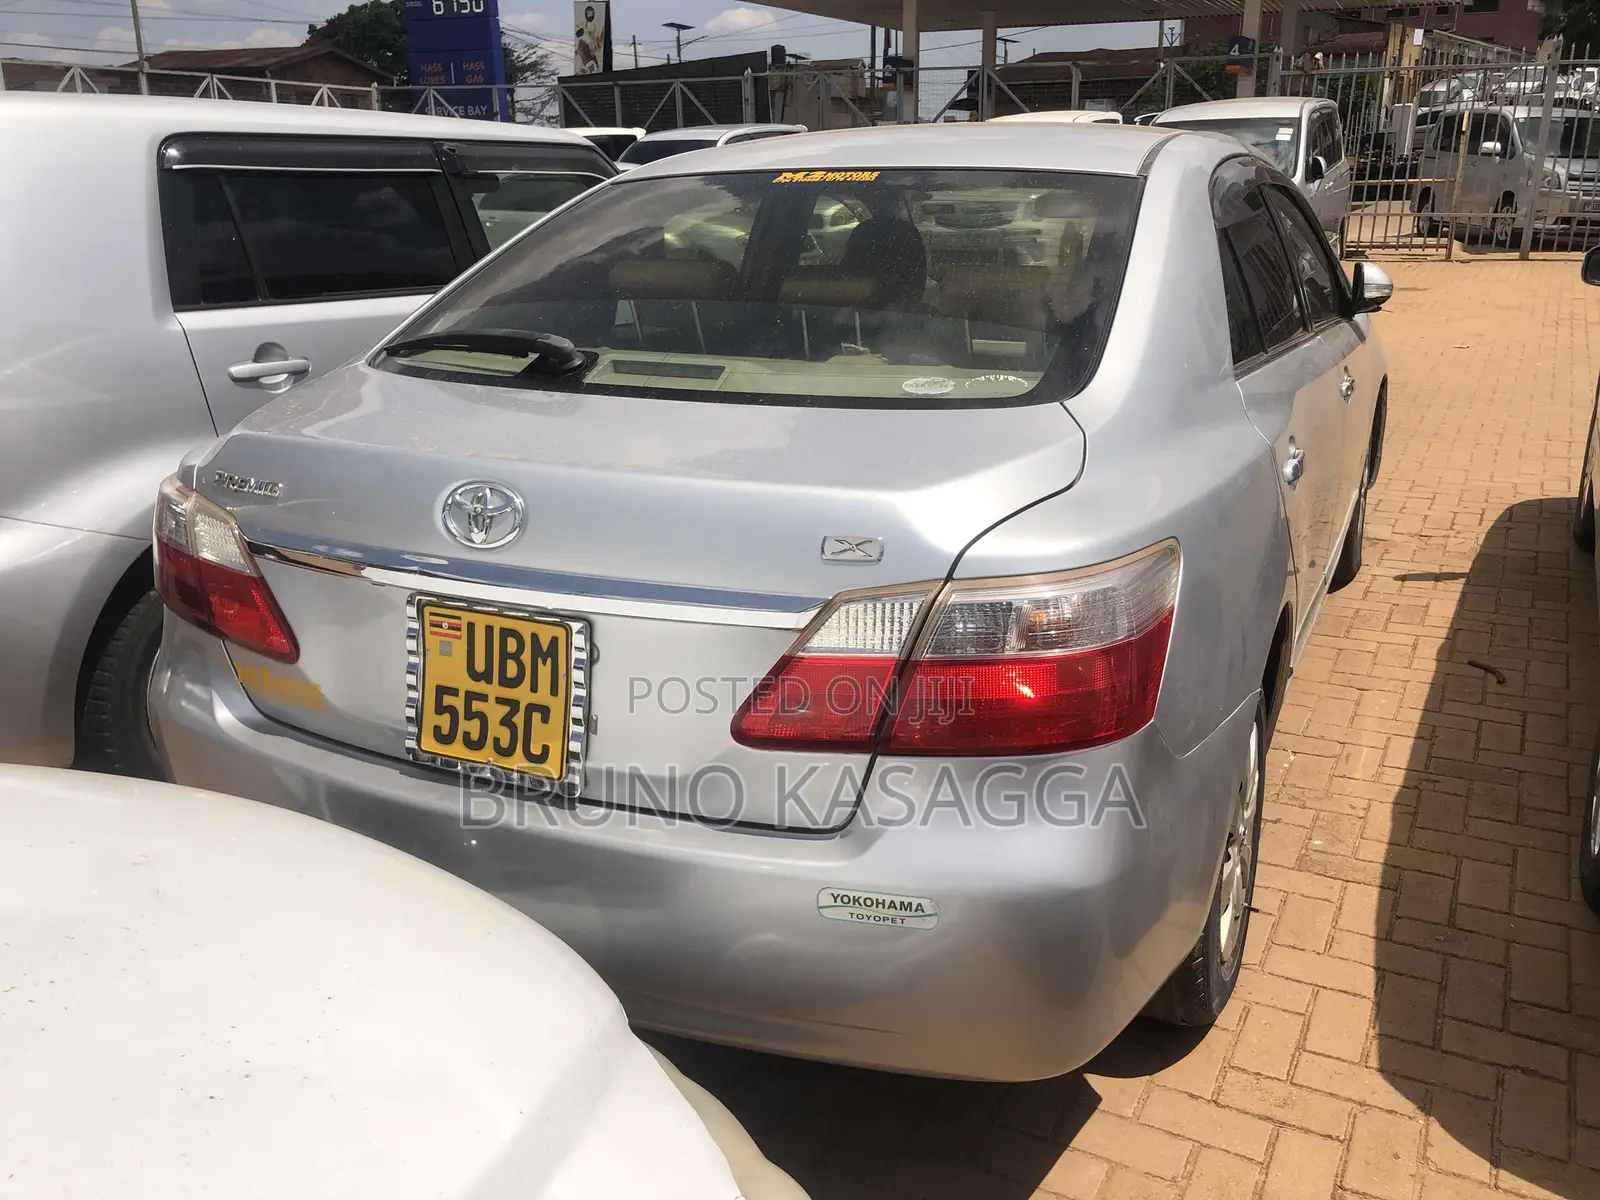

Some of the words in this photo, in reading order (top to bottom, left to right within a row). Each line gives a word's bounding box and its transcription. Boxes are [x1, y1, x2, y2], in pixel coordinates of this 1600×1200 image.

[1230, 44, 1239, 56] 4
[462, 61, 485, 70] HASS
[466, 75, 484, 84] GAS
[425, 106, 465, 117] SRVCE
[468, 105, 488, 116] BAY
[466, 621, 559, 697] UBM
[433, 685, 551, 764] 553C
[830, 892, 926, 914] YOKOHAMA
[848, 912, 906, 925] TOYOPET
